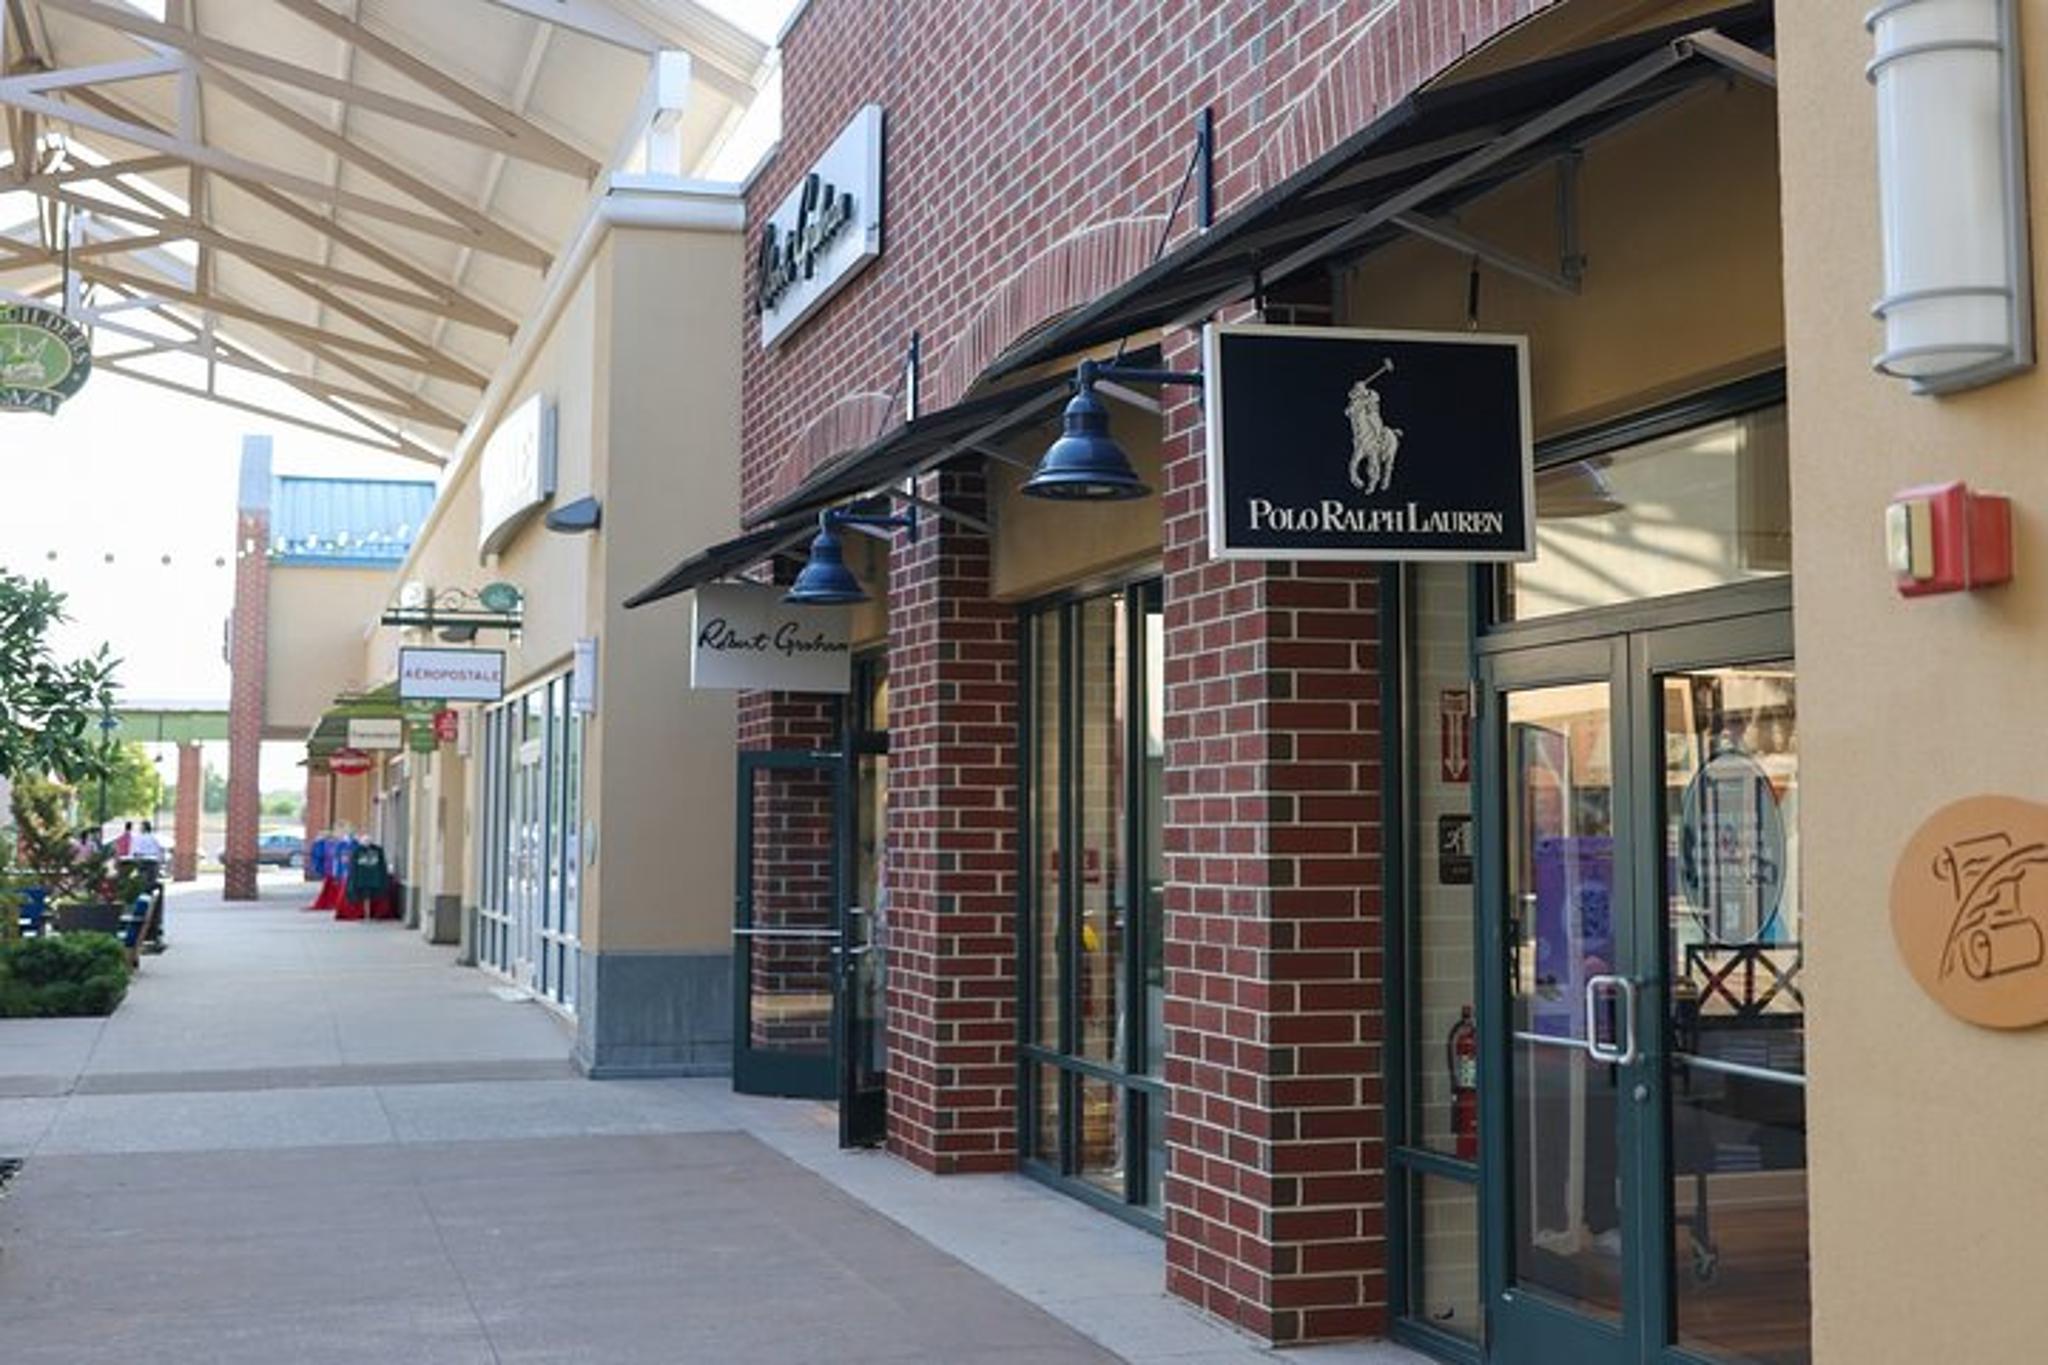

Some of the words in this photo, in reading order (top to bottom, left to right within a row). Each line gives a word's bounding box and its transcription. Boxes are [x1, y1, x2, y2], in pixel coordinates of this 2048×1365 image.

[1249, 499, 1319, 531] POLO
[1320, 500, 1402, 532] RALPH
[1407, 501, 1503, 534] LAUREN
[773, 621, 849, 657] Graham
